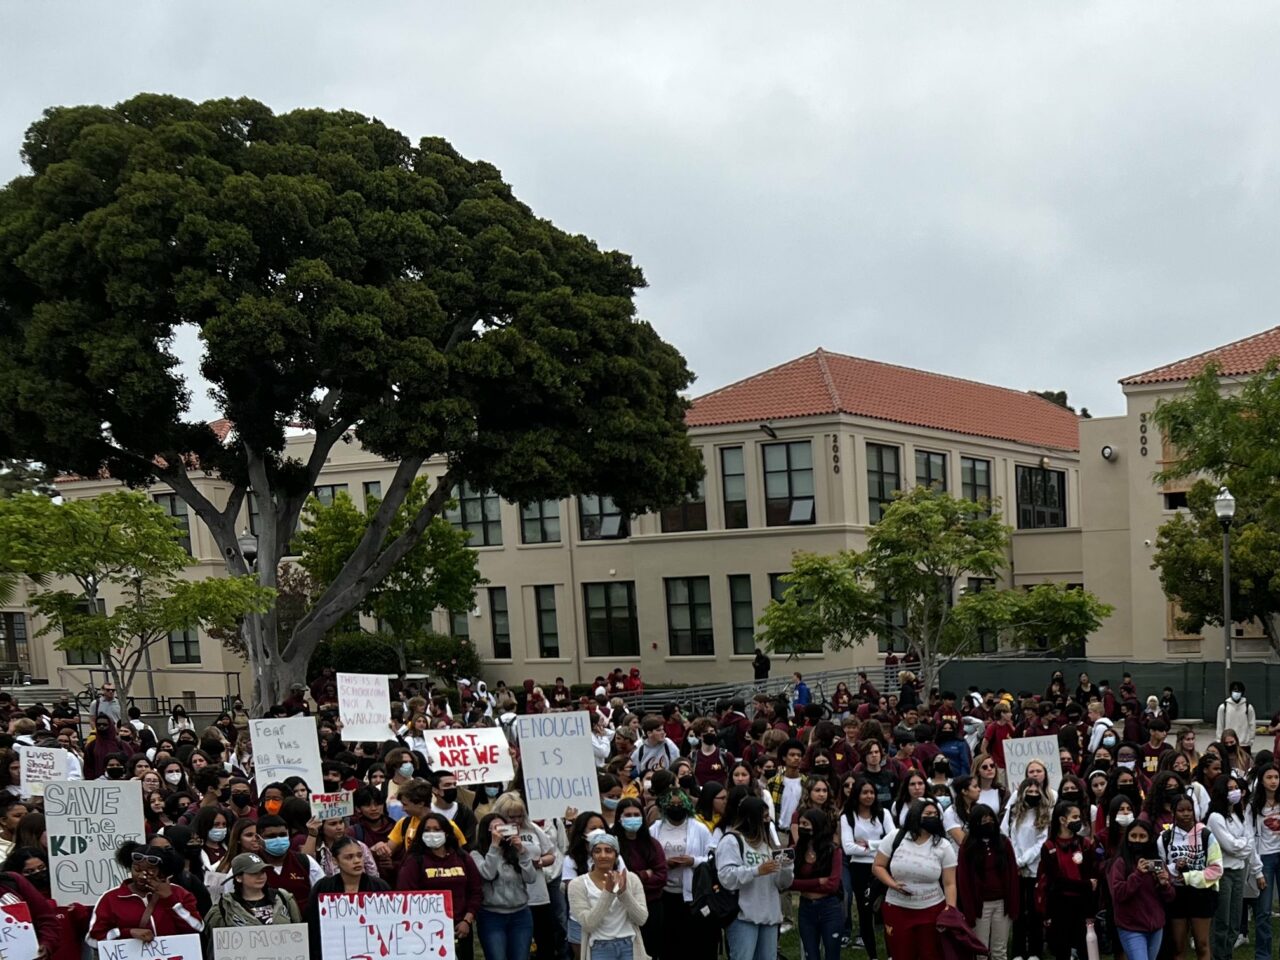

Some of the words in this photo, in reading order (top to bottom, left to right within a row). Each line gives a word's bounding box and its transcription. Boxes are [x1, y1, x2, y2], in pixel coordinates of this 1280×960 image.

[1140, 412, 1148, 457] 3000
[832, 433, 840, 474] 2000
[519, 715, 586, 739] ENOUGH
[278, 738, 300, 750] has
[26, 751, 54, 761] Lives
[439, 749, 472, 767] ARE
[474, 745, 500, 765] WE
[541, 748, 564, 766] IS
[312, 793, 350, 803] PROTECT
[526, 776, 594, 800] ENOUGH
[45, 784, 121, 816] SAVE
[67, 817, 116, 834] The
[328, 895, 359, 918] HOW
[364, 895, 403, 916] MANY
[409, 895, 443, 915] MORE
[140, 939, 171, 958] ARE
[215, 931, 243, 950] NO
[250, 929, 304, 948] More
[342, 919, 445, 960] LIVES?
